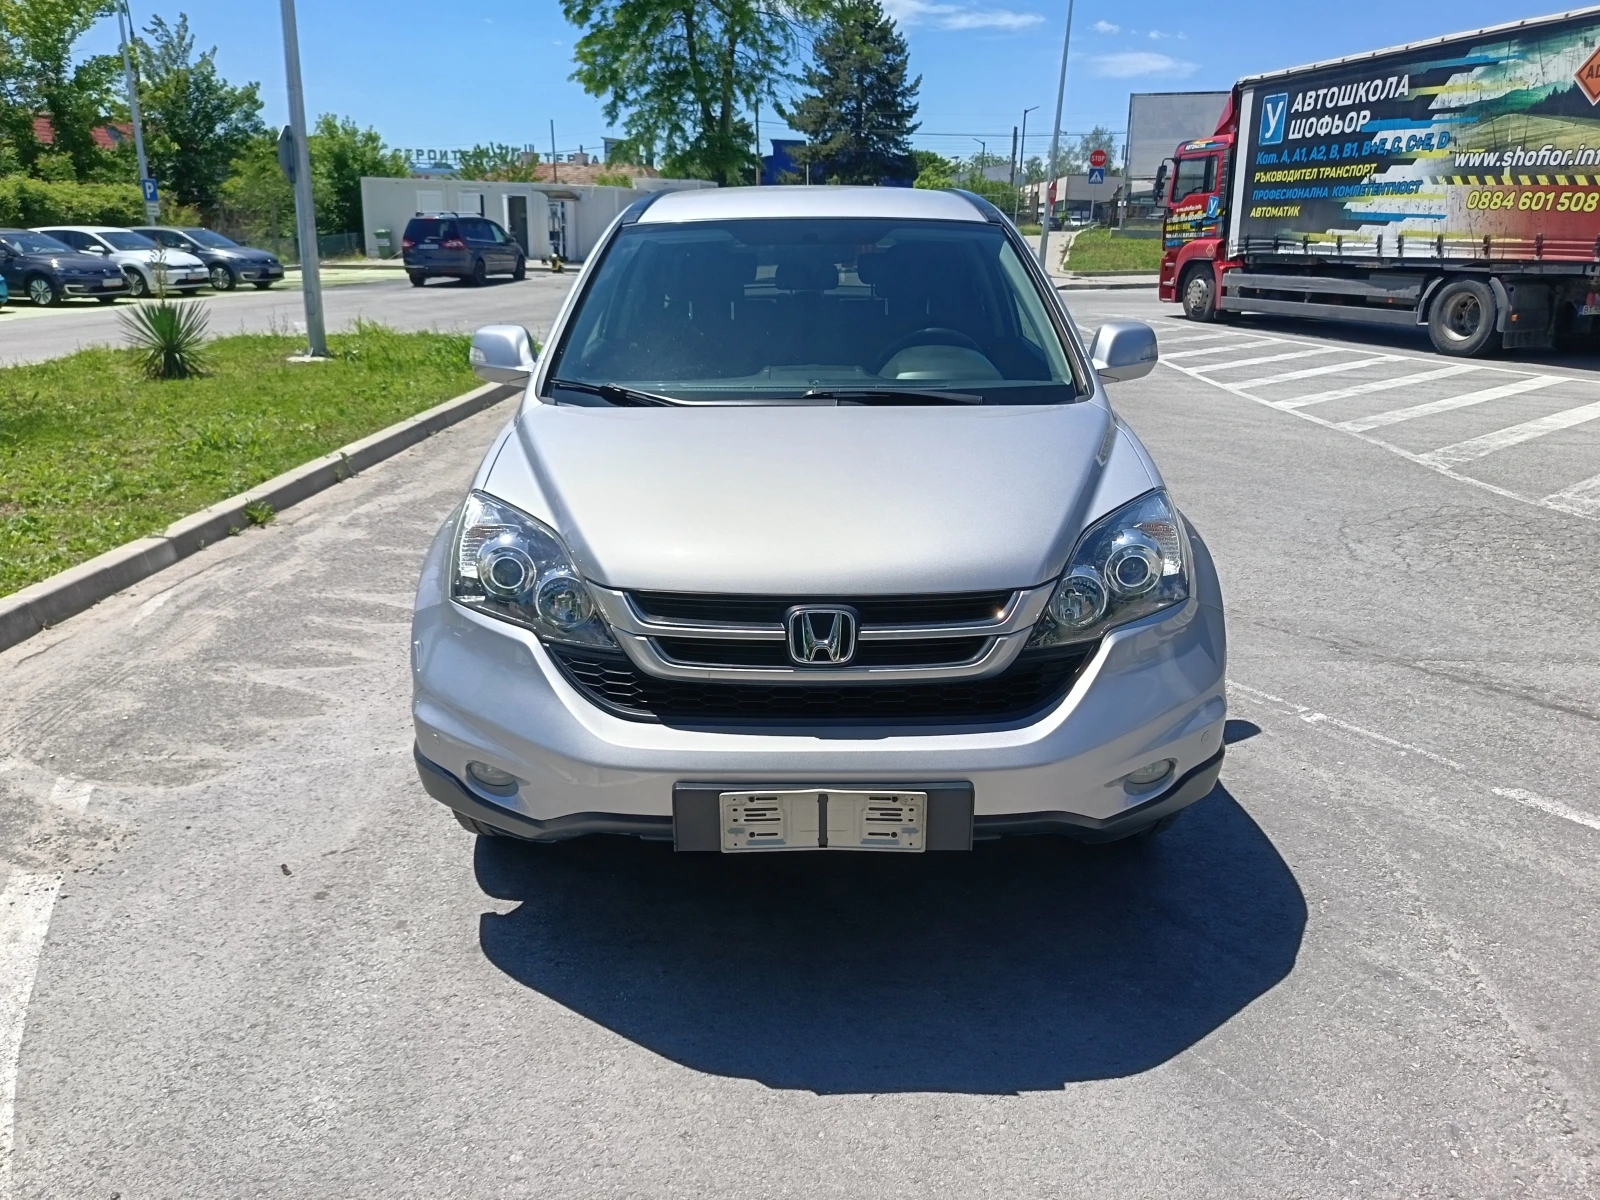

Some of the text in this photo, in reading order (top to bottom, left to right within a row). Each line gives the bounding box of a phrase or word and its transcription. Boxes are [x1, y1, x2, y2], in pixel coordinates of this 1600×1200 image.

[1291, 74, 1409, 113] АВТОШКОЛА
[1265, 102, 1284, 139] У
[1288, 110, 1371, 140] ШОФЬОР
[1436, 131, 1450, 149] D
[1254, 162, 1378, 183] РЪКОВОДИТЕЛ ТРАНСПОРТ
[145, 181, 155, 199] P
[1252, 179, 1423, 200] ПРОФЕСИОНАЛНА КОМПЕТЕНТНОСТ
[1250, 206, 1301, 217] АВТОМАТИК
[1467, 190, 1600, 212] 0884 601 508
